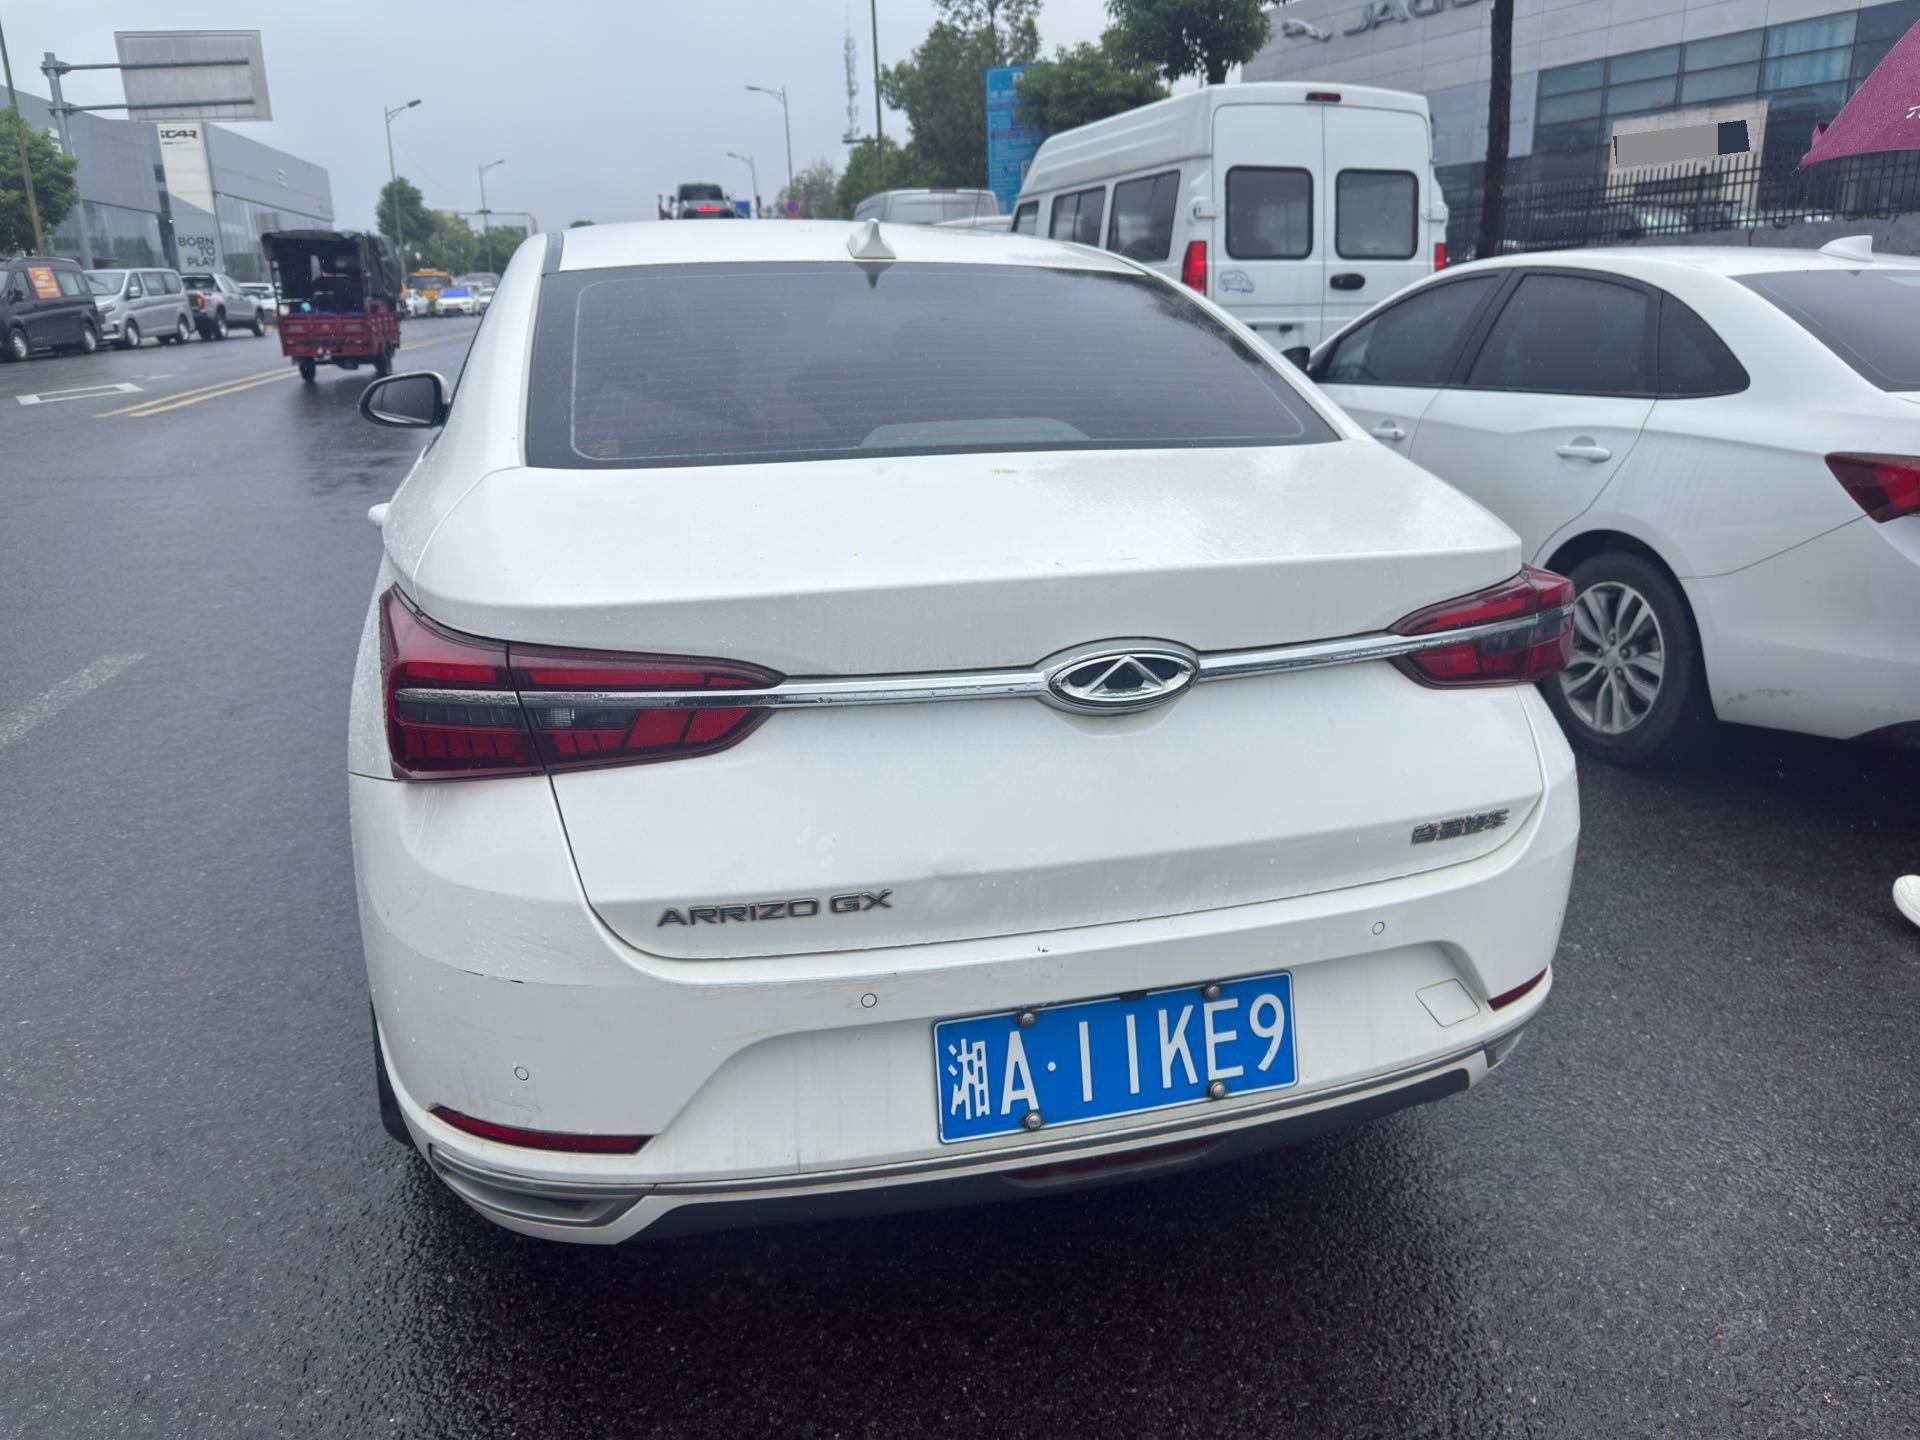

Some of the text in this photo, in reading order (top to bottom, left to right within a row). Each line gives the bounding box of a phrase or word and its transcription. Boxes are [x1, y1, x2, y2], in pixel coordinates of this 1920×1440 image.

[177, 236, 215, 247] BORN
[198, 245, 216, 256] TO
[187, 256, 217, 267] PLAY
[656, 888, 894, 928] ARRIZO GX
